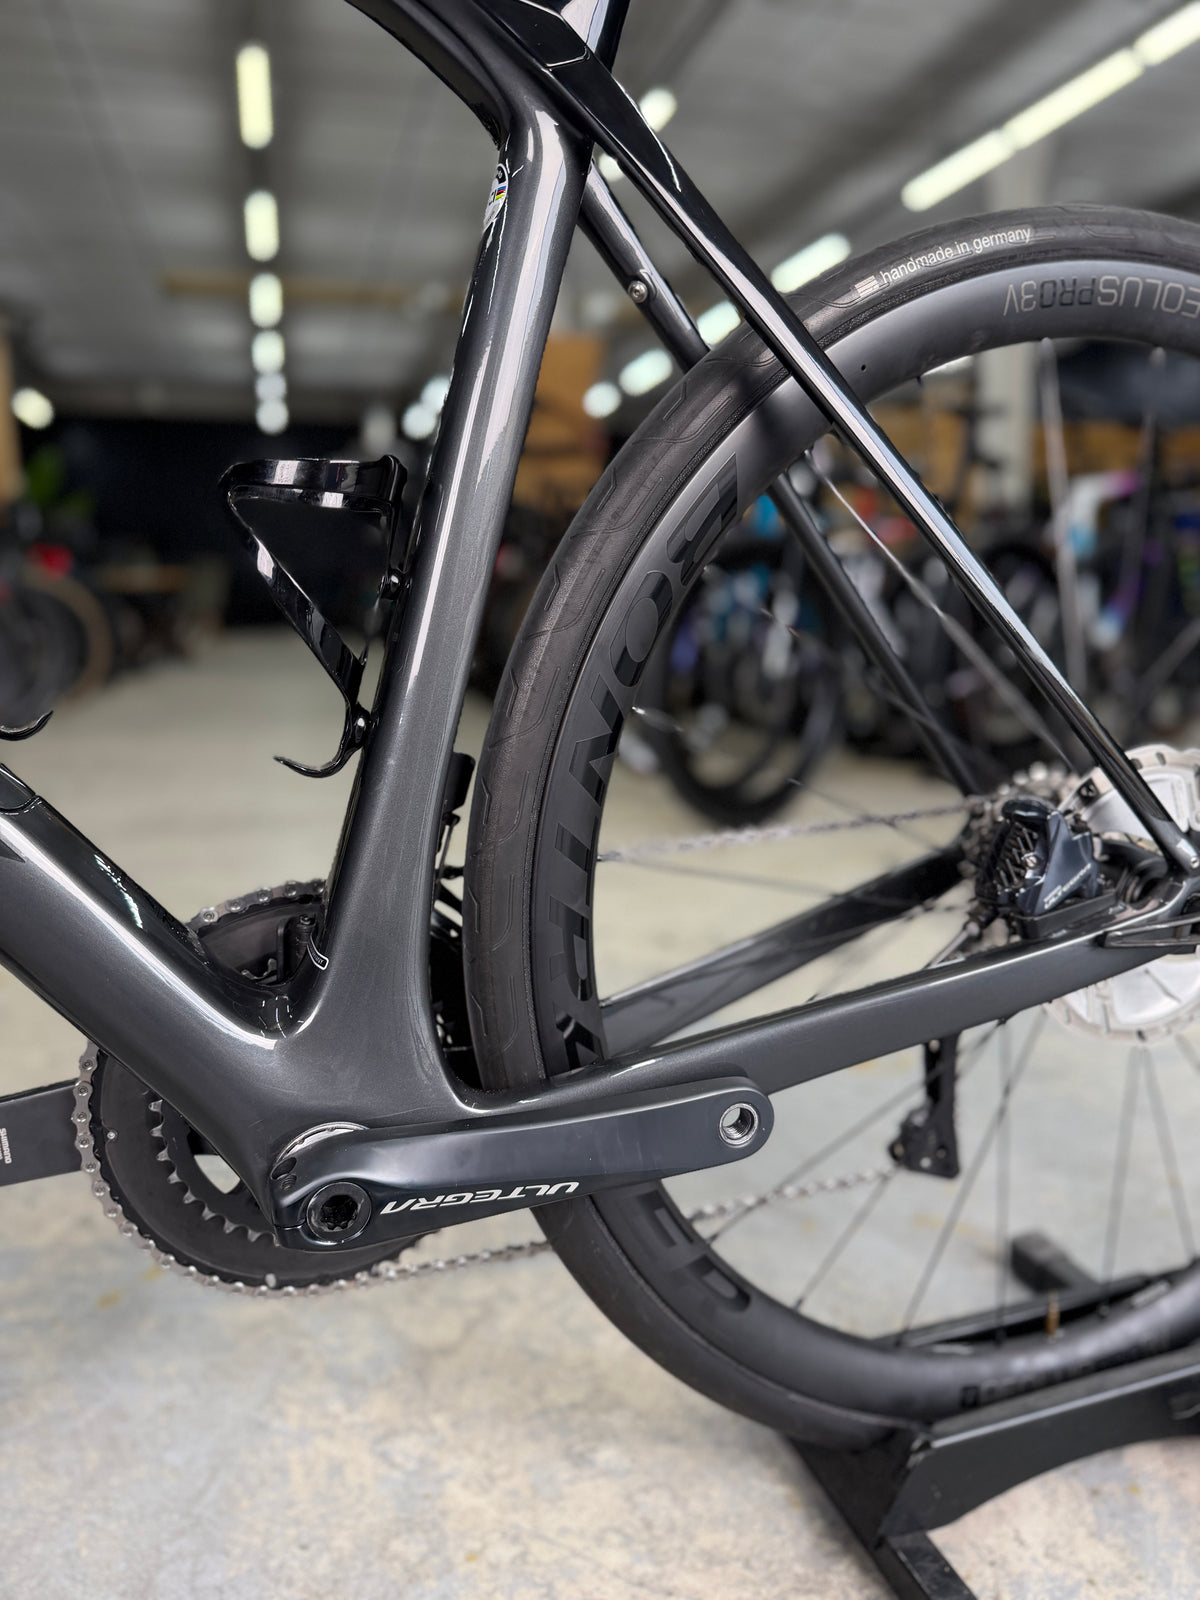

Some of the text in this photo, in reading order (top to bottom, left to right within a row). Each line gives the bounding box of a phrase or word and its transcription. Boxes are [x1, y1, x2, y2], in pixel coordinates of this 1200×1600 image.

[880, 227, 1031, 284] handmade in germany
[380, 1181, 580, 1215] ULTEGRA
